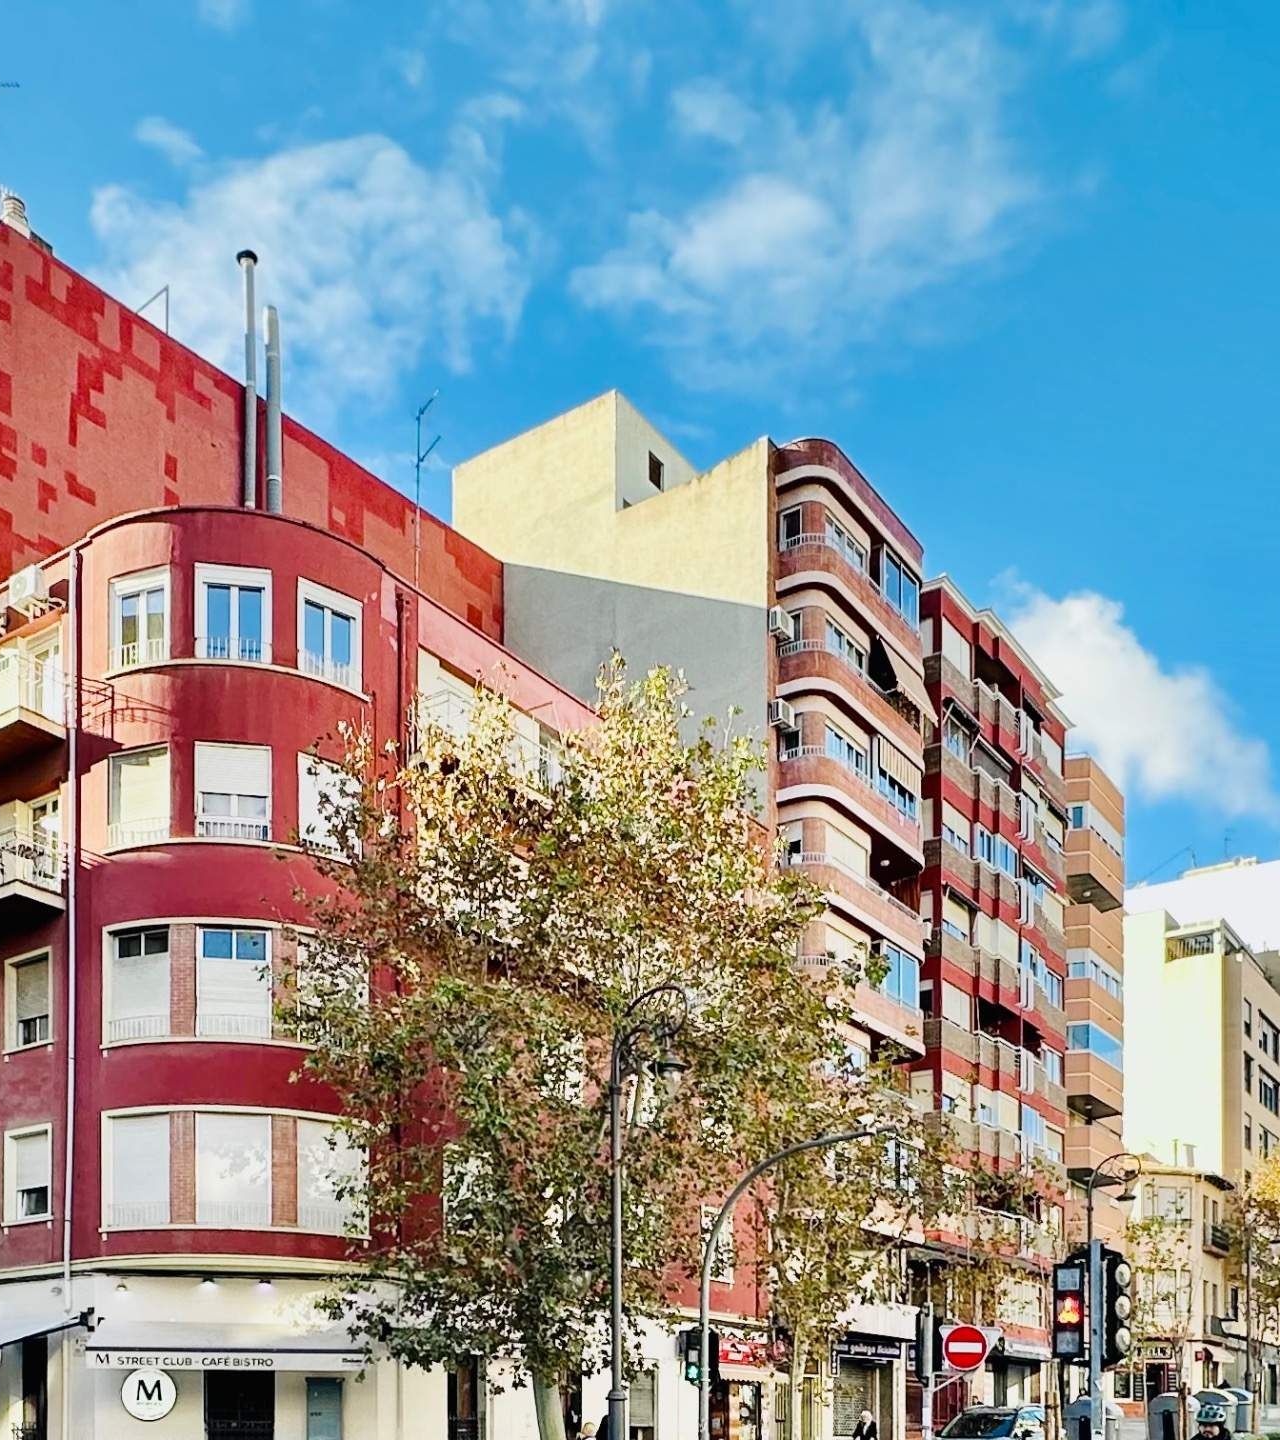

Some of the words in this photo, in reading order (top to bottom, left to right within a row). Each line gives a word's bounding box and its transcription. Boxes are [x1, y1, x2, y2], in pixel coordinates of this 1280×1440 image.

[95, 1353, 110, 1365] M
[117, 1356, 159, 1366] STREET
[162, 1357, 192, 1366] CLUB
[201, 1355, 230, 1367] CAFÉ
[233, 1358, 273, 1368] BISTRO
[136, 1380, 162, 1401] M
